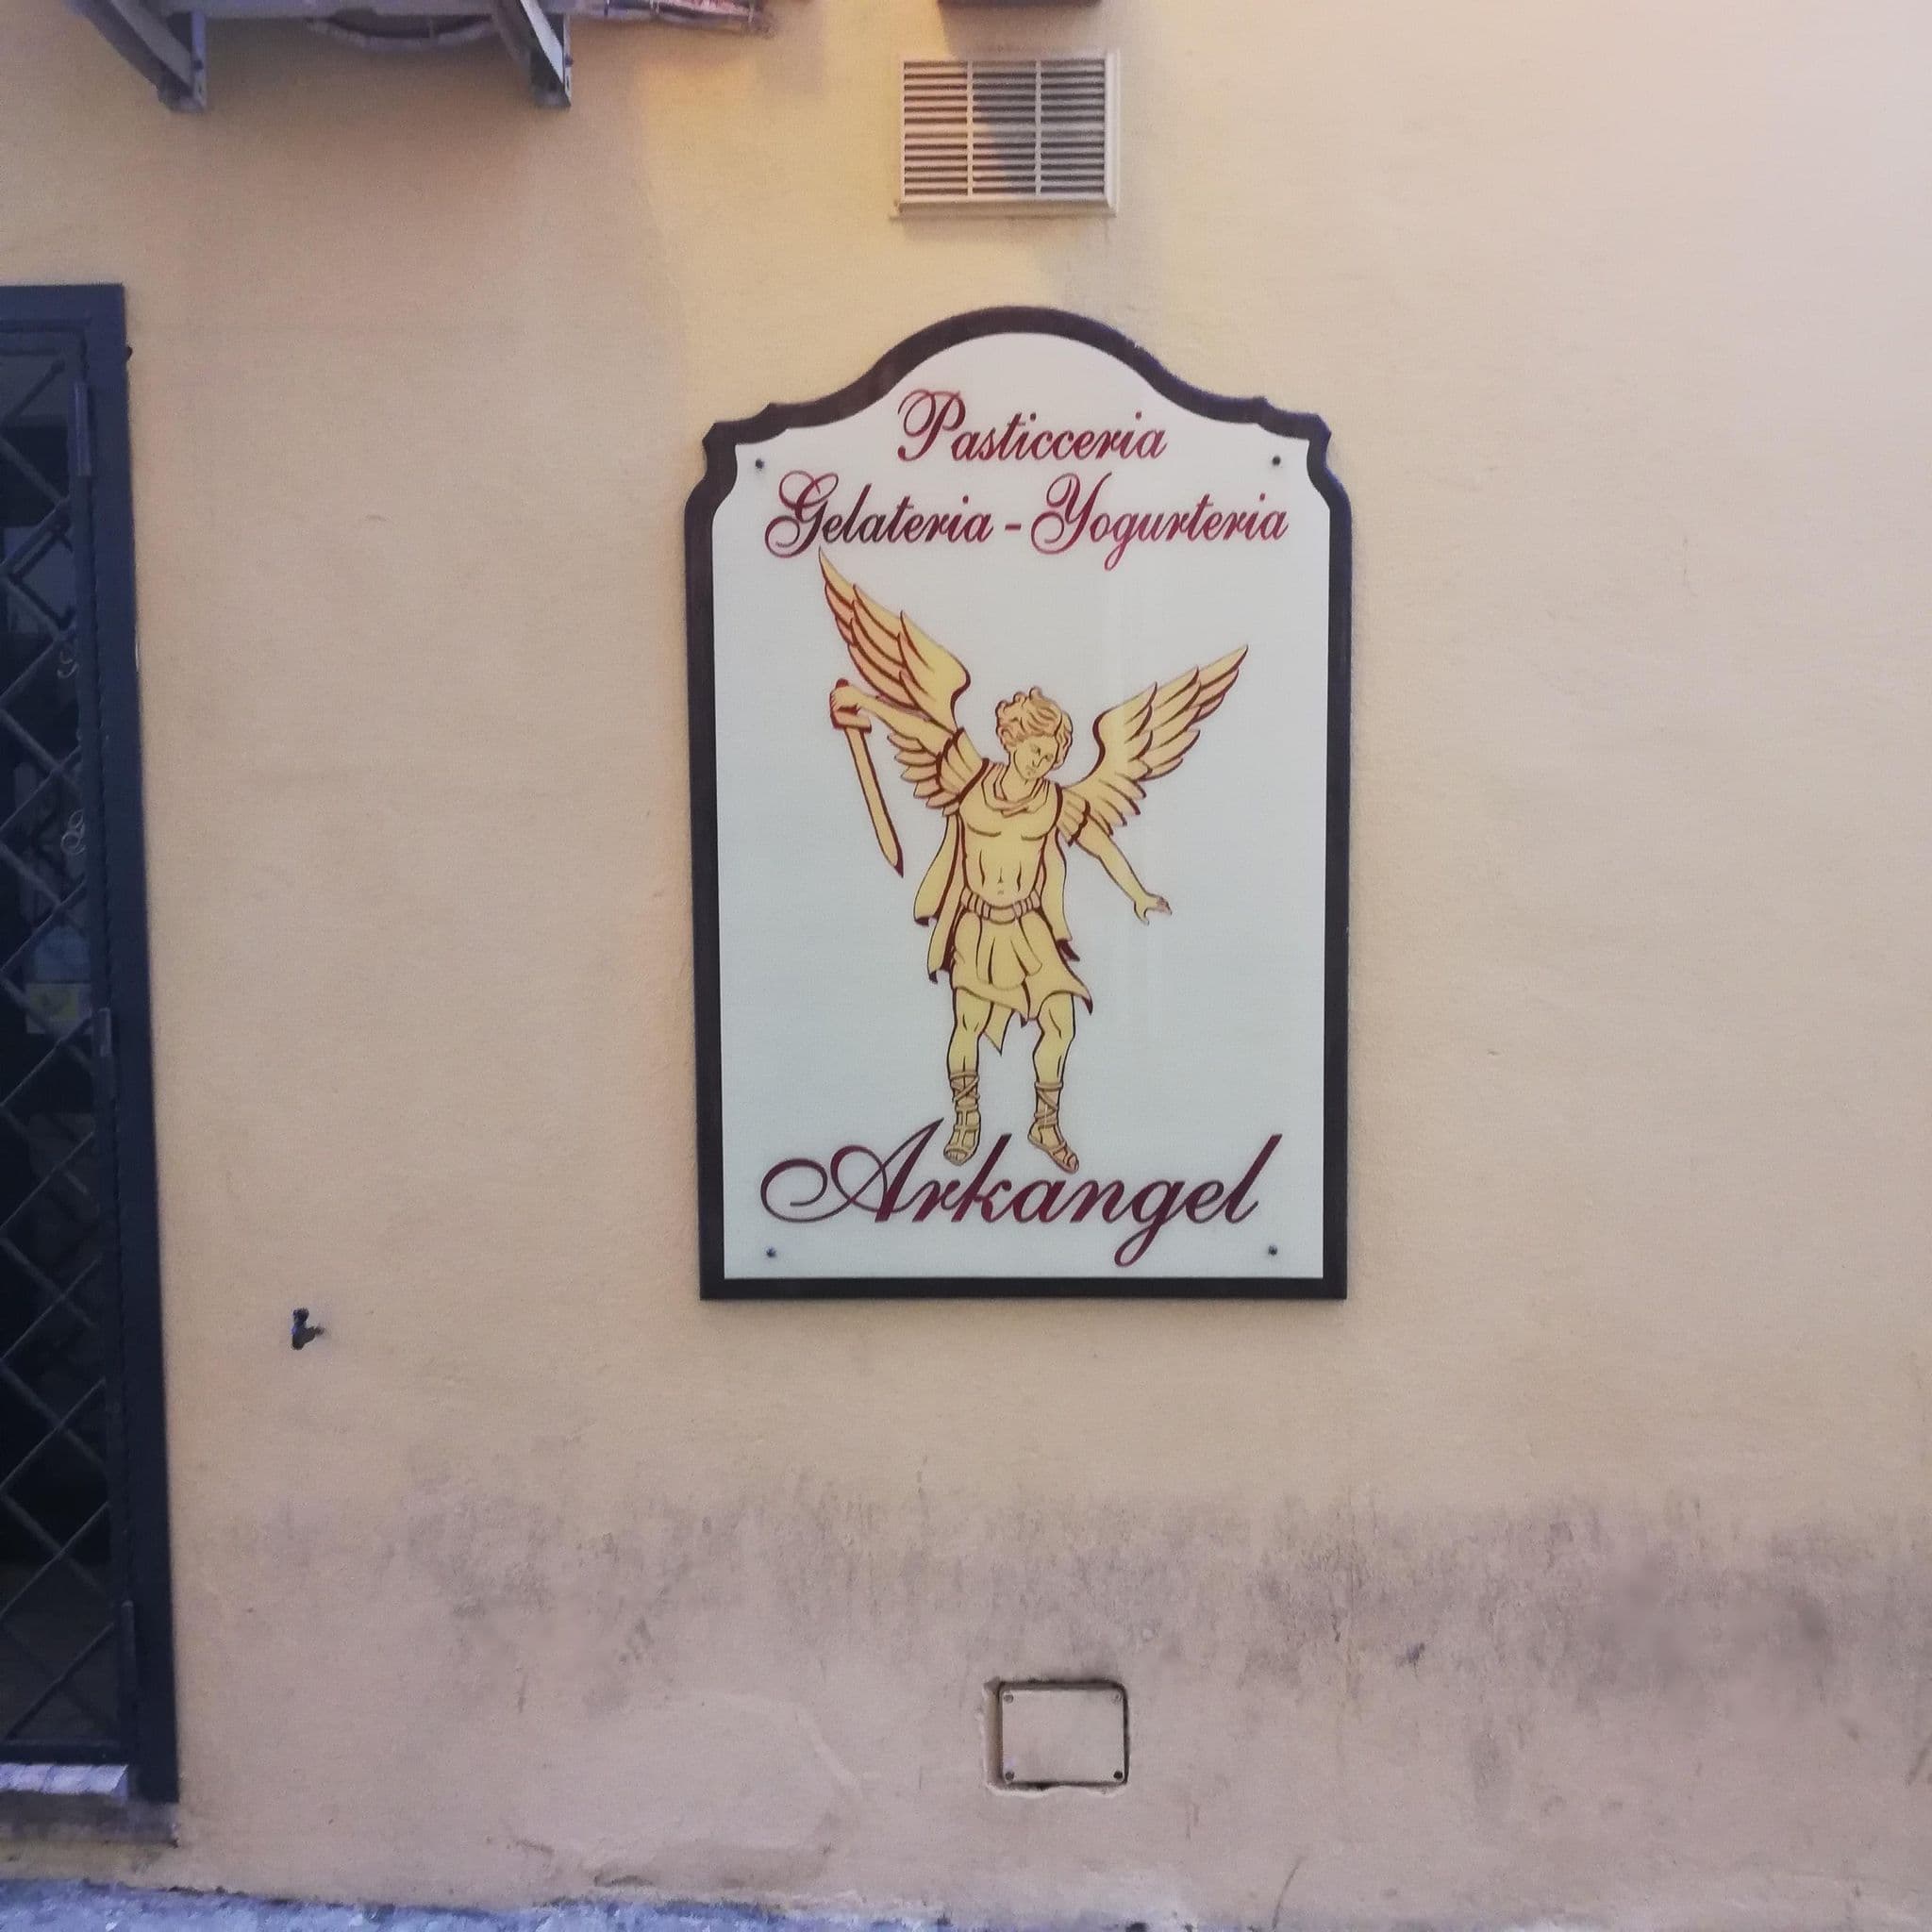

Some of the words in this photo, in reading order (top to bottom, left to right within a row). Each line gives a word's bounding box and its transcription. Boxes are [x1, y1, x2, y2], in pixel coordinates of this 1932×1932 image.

[897, 389, 1167, 462] Pasticceria
[764, 470, 994, 558] Gelateria
[1030, 471, 1290, 572] Yogurteria
[760, 1117, 1283, 1268] Arkangel
